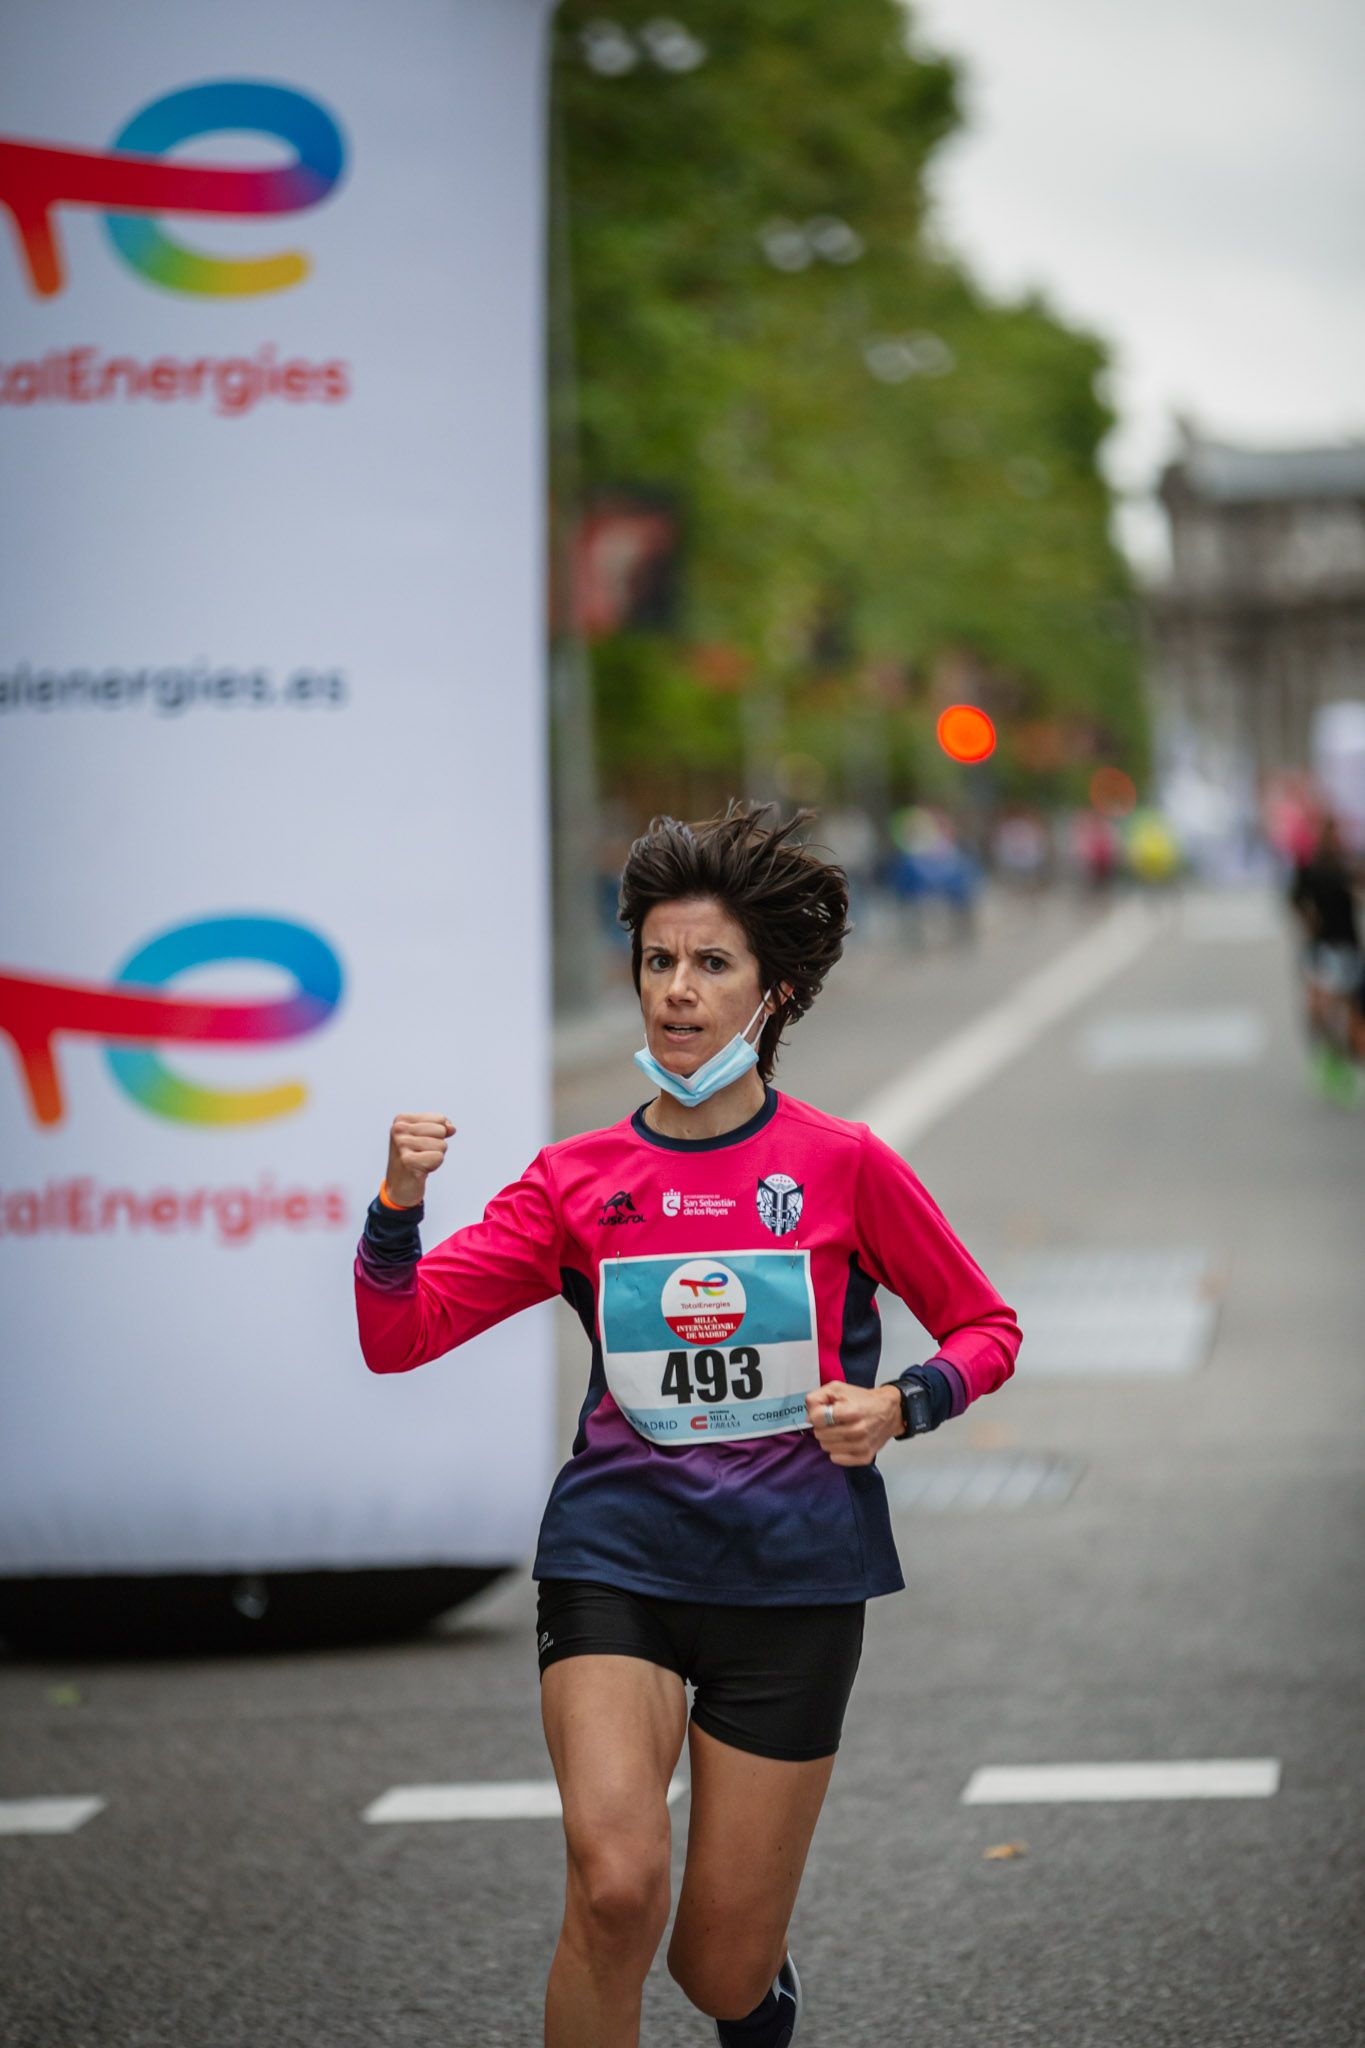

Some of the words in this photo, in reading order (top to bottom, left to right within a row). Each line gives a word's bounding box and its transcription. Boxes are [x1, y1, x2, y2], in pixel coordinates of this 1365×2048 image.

[683, 1199, 698, 1207] San
[706, 1207, 729, 1217] Reyes
[681, 1301, 731, 1310] TotalEnergies
[693, 1316, 718, 1324] MILLA
[676, 1322, 736, 1332] INTERNACIONAL
[698, 1330, 728, 1339] MADRID
[661, 1346, 763, 1405] 493
